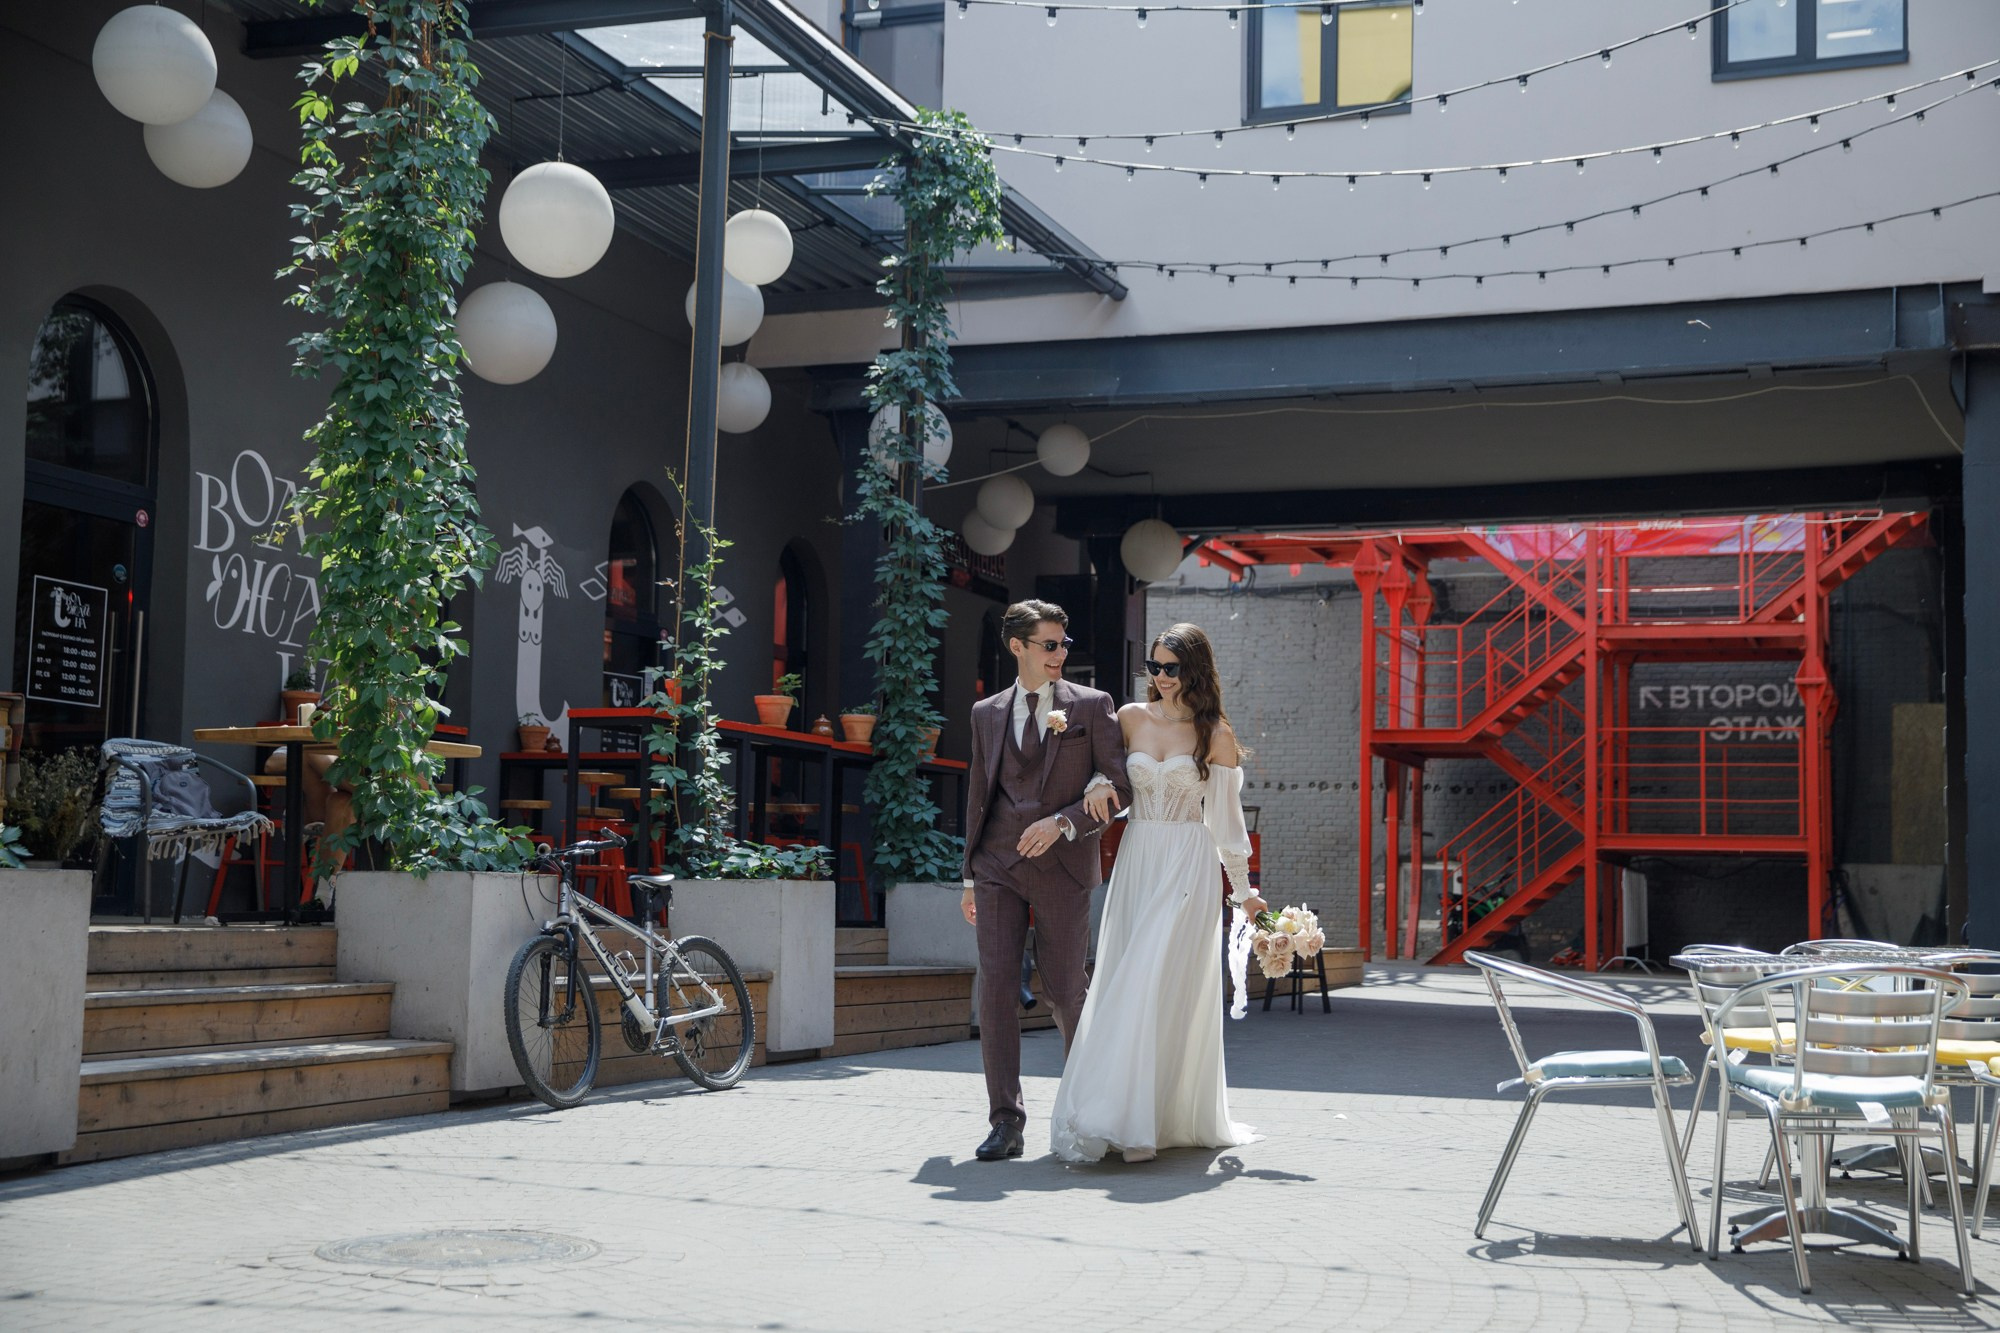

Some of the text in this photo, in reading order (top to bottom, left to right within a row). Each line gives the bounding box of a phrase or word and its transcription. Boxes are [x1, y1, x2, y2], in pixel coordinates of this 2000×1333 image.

[81, 649, 97, 658] 02:00
[62, 659, 77, 669] 12:00
[80, 662, 96, 671] 02:00
[61, 672, 77, 681] 12:00
[60, 686, 76, 695] 12:00
[78, 688, 95, 697] 02:00
[1669, 676, 1805, 709] ВТОРОЙ
[1709, 716, 1804, 740] ЭТАЖ
